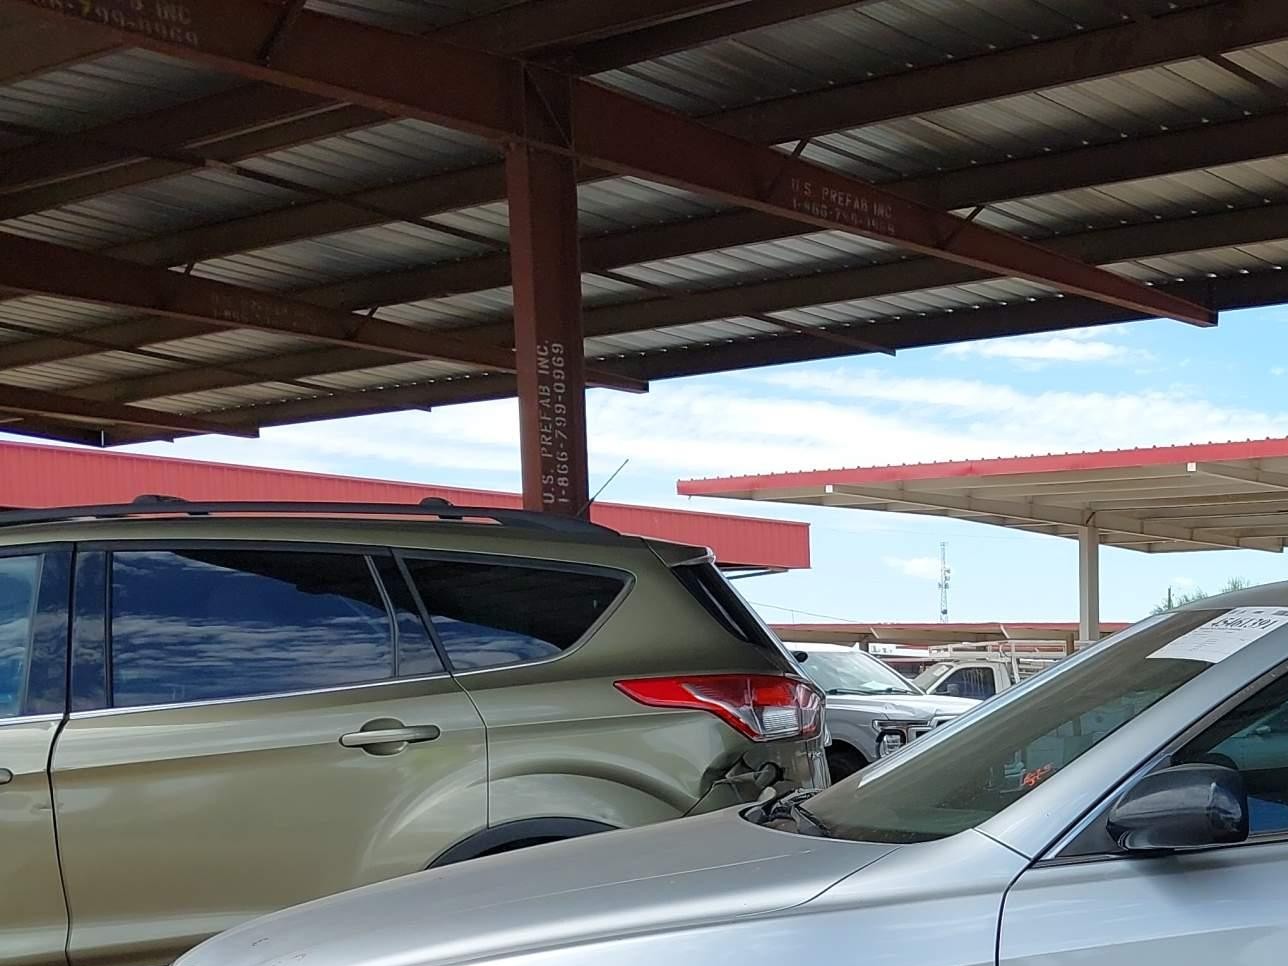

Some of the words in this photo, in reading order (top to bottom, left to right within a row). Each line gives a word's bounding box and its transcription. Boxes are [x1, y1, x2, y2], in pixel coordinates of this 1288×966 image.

[536, 339, 551, 375] INC.
[538, 384, 554, 458] PREFAB
[551, 342, 570, 504] 1-866-799-0969
